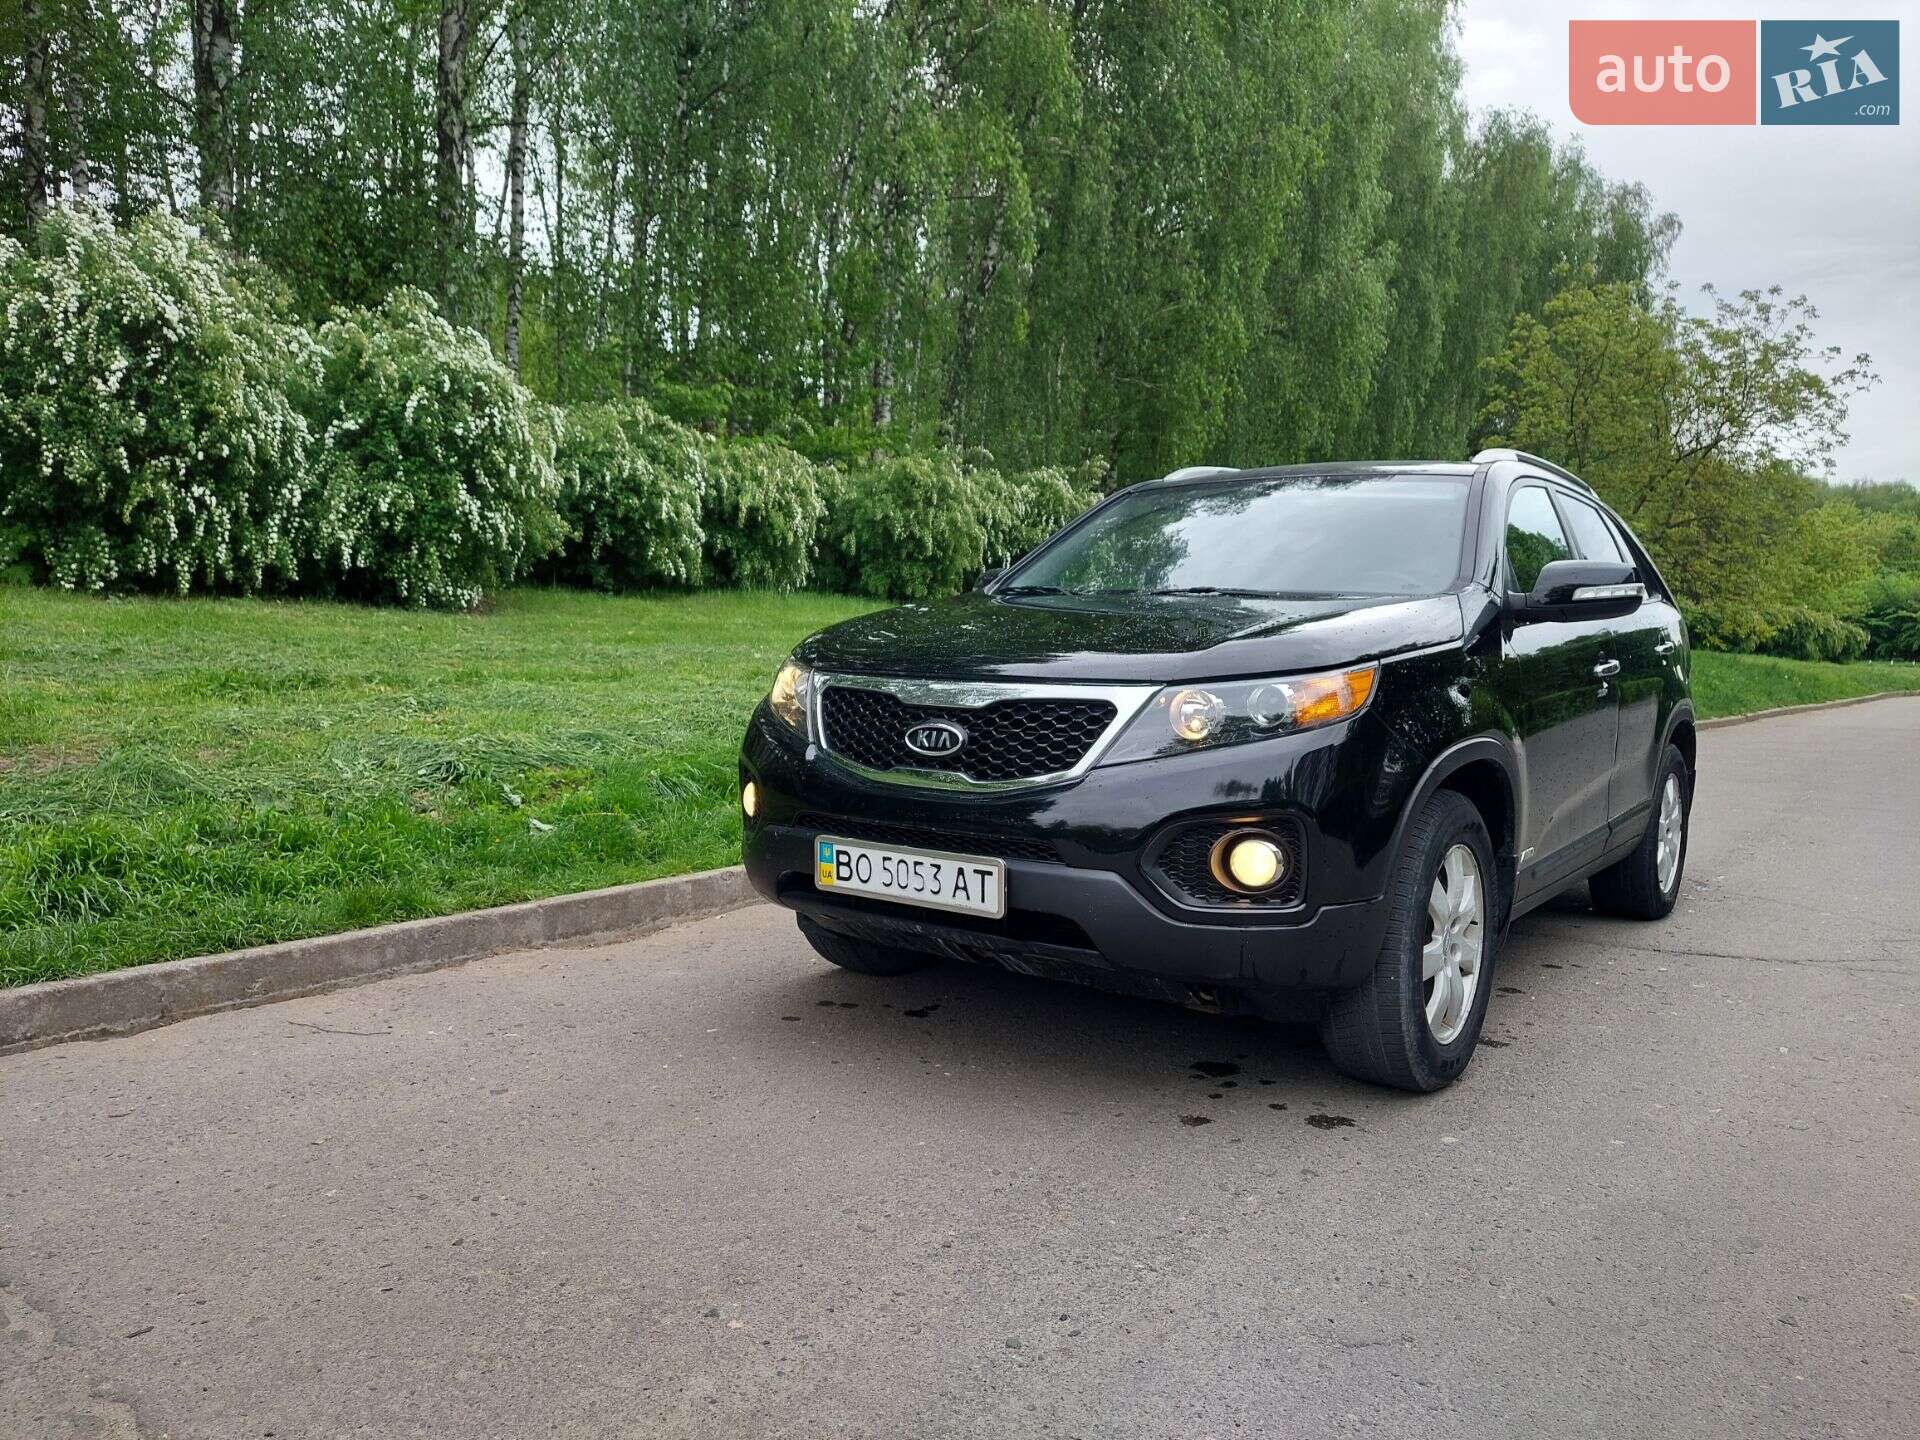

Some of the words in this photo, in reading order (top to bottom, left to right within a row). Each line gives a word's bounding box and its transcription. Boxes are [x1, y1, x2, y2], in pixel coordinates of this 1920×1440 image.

[916, 730, 951, 748] KIA
[822, 869, 833, 880] UA
[835, 850, 872, 884] BO
[882, 856, 942, 895] 5053
[952, 866, 993, 904] AT
